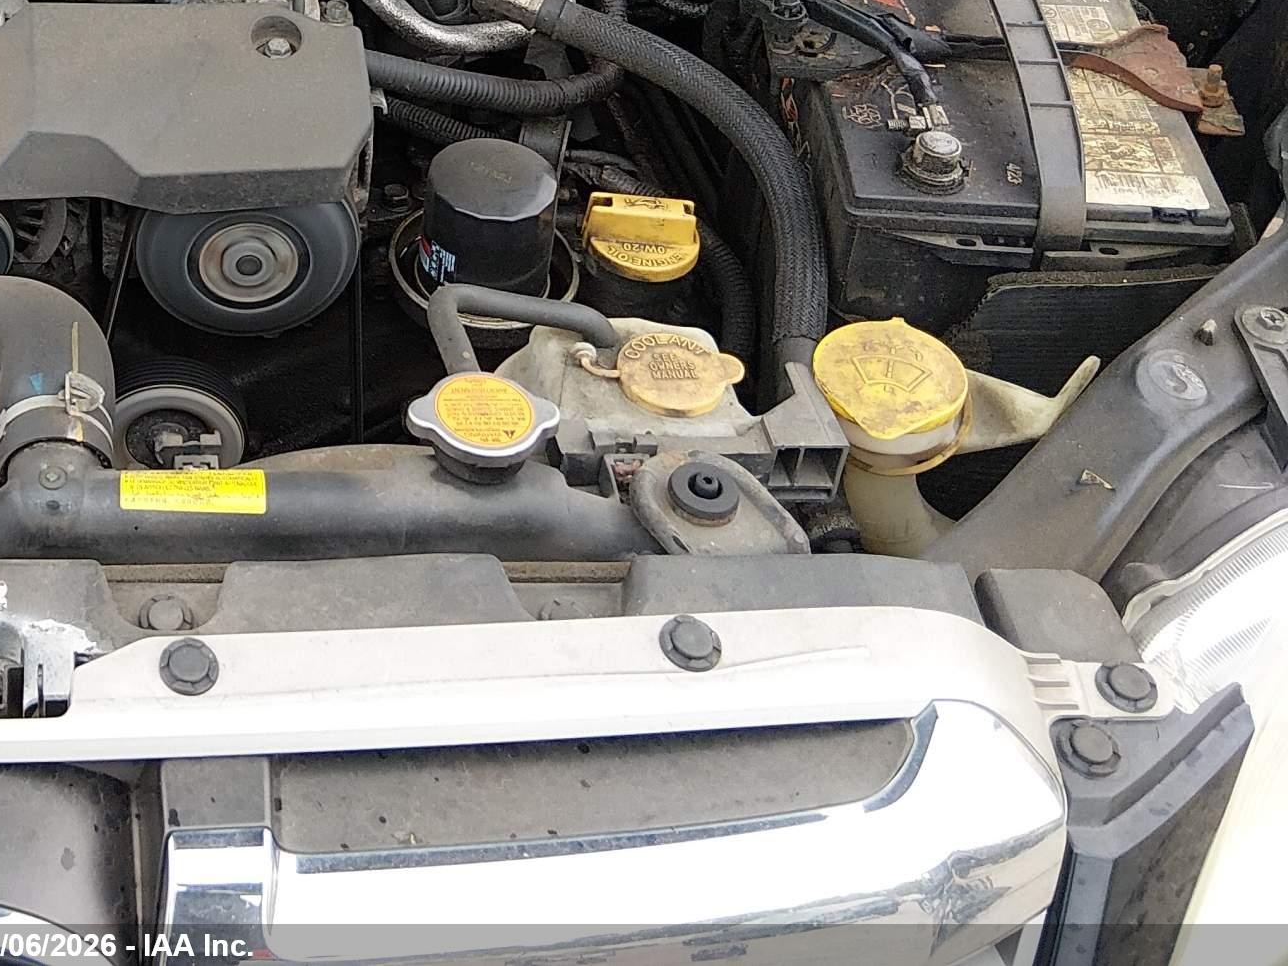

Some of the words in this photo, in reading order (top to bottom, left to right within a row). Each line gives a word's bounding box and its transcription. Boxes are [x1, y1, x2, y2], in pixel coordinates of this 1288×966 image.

[607, 245, 628, 261] OIL
[632, 252, 684, 267] ENGINE
[624, 334, 708, 359] COOLANT
[652, 353, 678, 362] SEE
[652, 369, 699, 379] MANUAL
